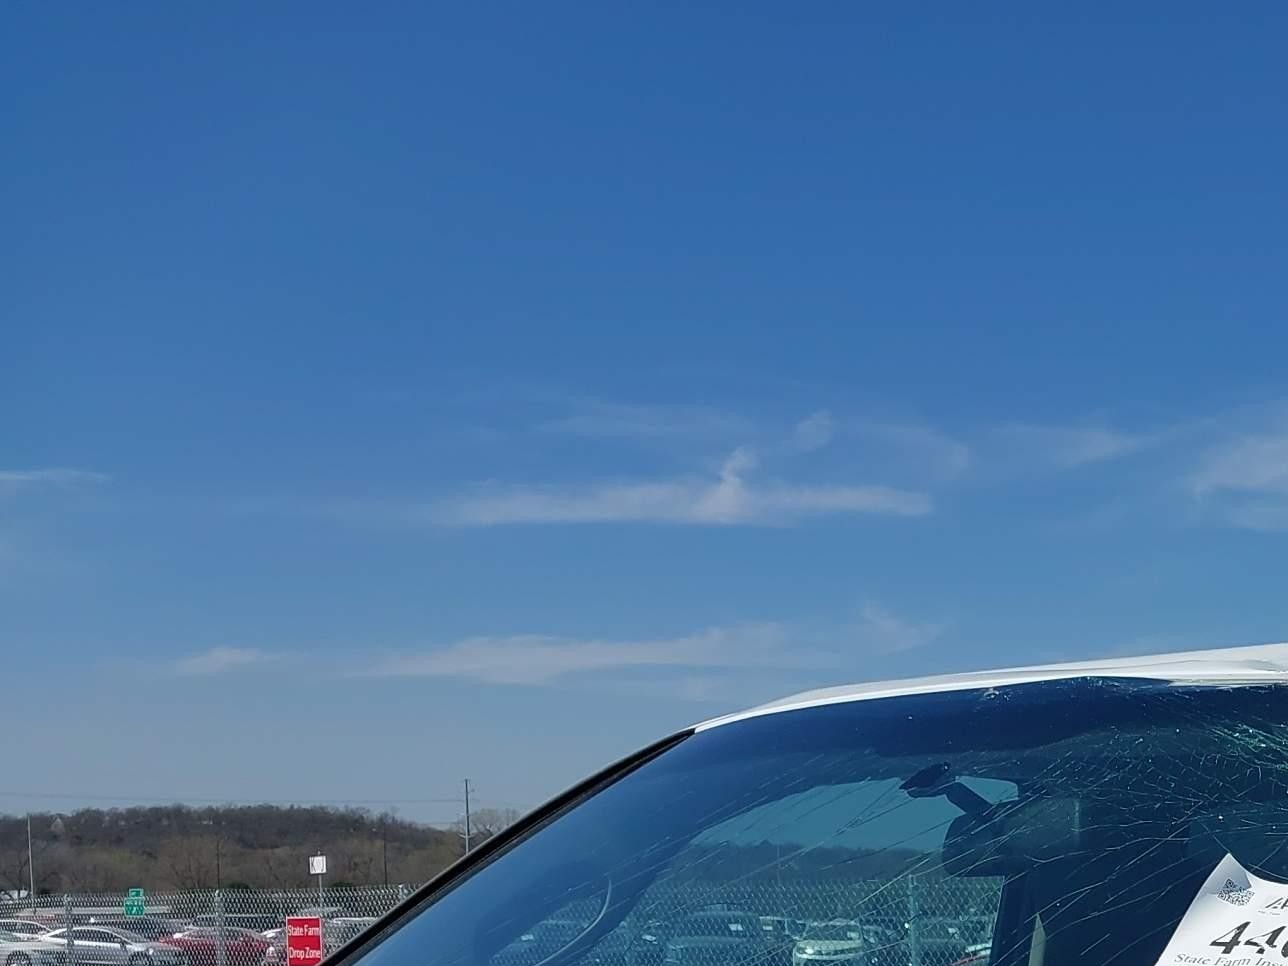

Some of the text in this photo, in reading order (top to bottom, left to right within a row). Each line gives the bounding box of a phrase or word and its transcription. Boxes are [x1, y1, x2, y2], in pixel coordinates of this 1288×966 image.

[288, 925, 320, 936] State Farm
[289, 947, 321, 960] Drop Zone
[1174, 953, 1211, 966] State
